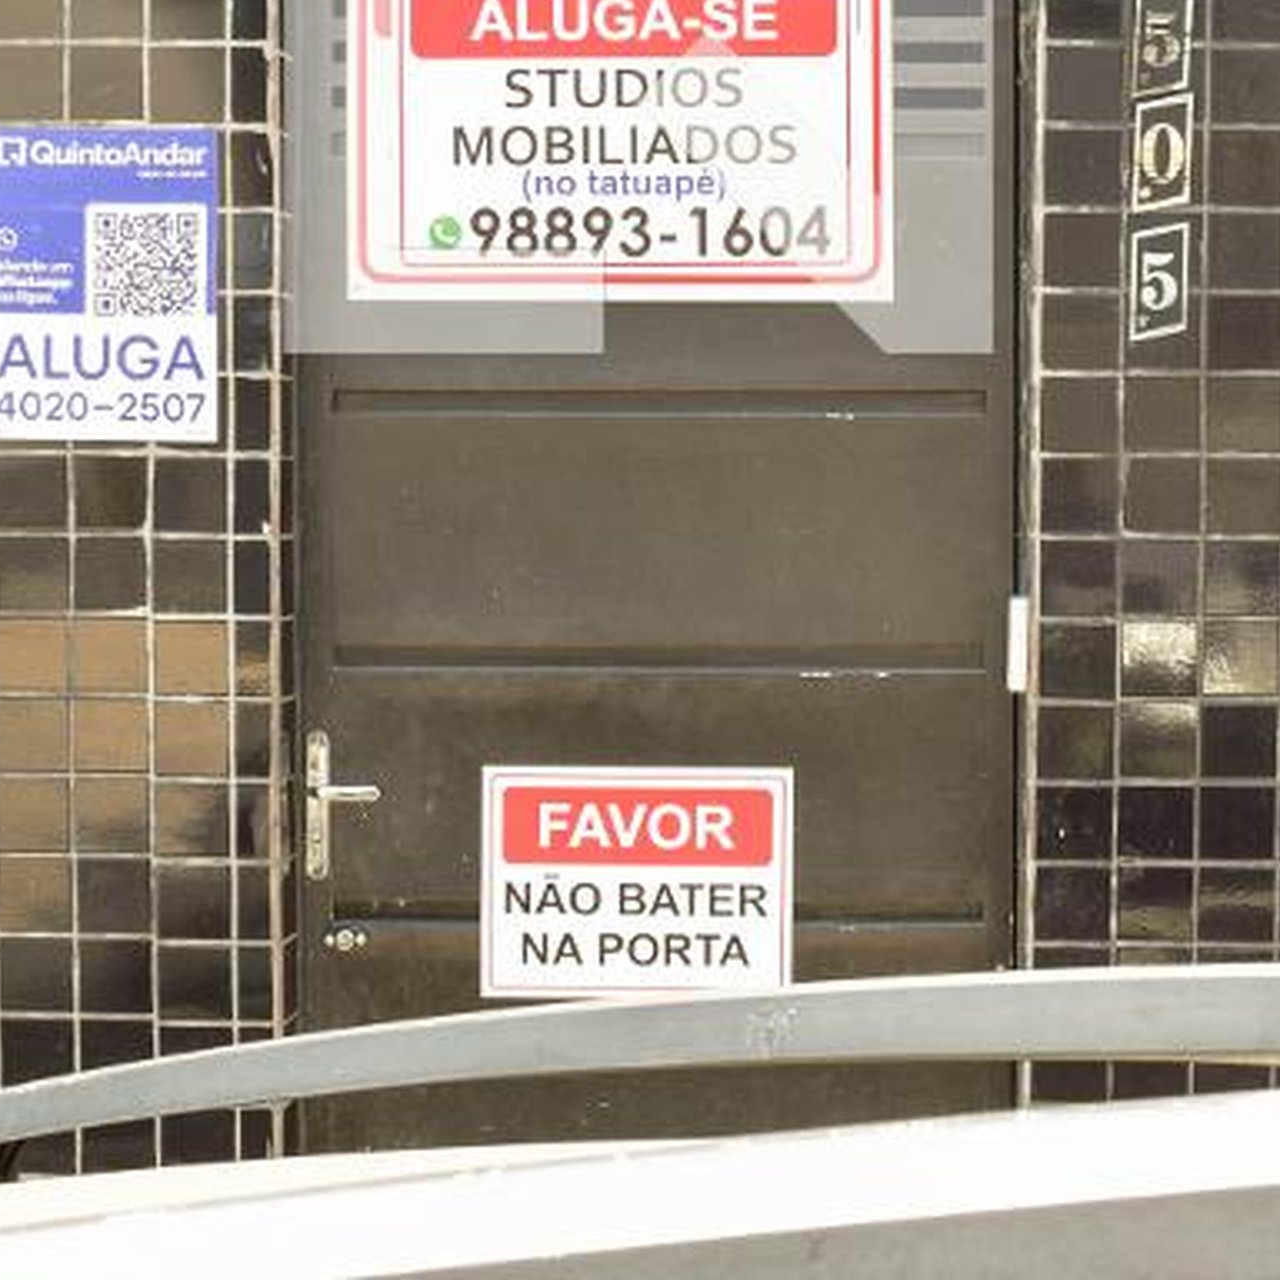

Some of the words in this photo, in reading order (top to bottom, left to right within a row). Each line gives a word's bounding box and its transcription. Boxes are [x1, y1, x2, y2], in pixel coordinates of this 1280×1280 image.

[505, 67, 745, 108] STUDIOS
[30, 136, 209, 166] QuintoAndar
[452, 124, 799, 166] MOBILIADOS
[521, 168, 577, 202] (no
[587, 166, 727, 202] tatuapé)
[469, 204, 832, 258] 98893-1604
[538, 802, 734, 850] FAVOR
[504, 873, 603, 916] NÃO
[618, 882, 768, 918] BATER
[521, 932, 584, 966] NA
[598, 932, 750, 968] PORTA
